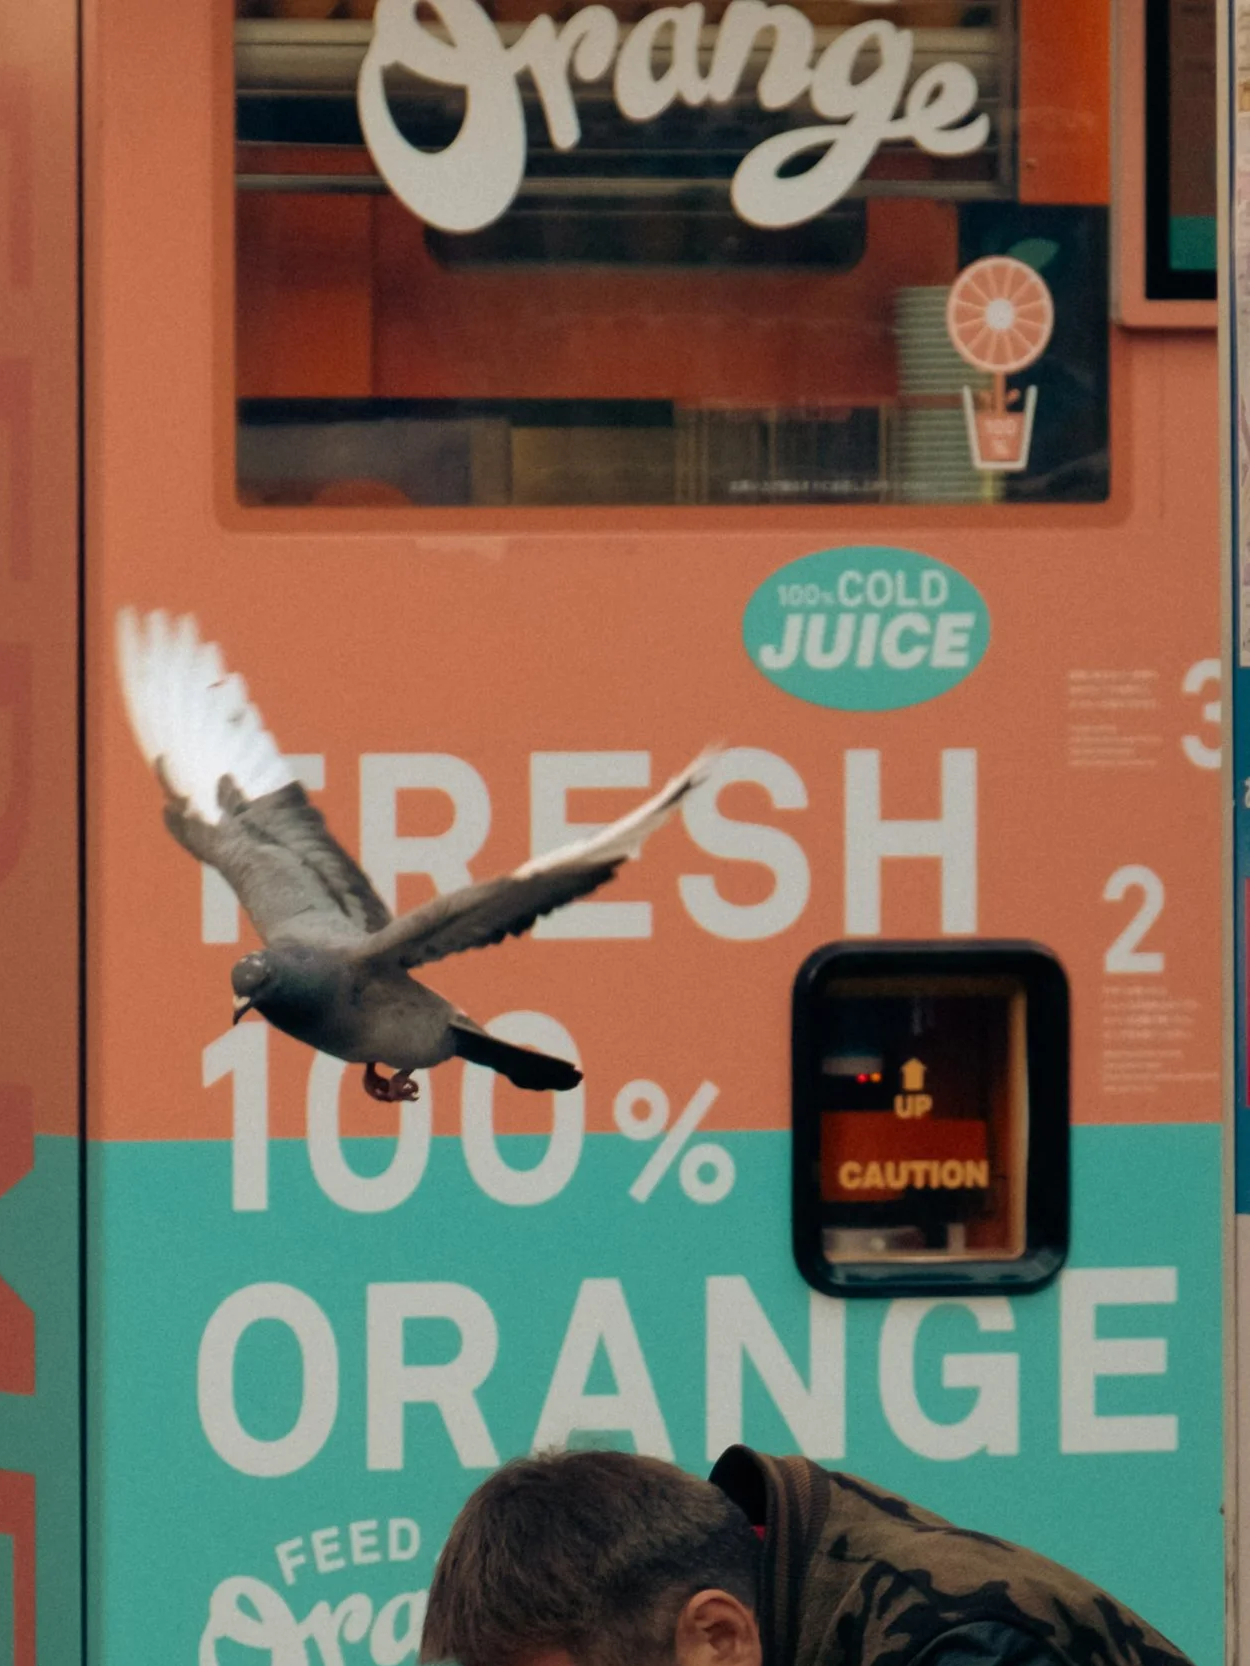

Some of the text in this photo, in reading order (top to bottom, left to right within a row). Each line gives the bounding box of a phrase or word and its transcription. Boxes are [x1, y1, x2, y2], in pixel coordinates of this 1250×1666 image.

[357, 0, 990, 233] Orange
[838, 568, 949, 608] COLD
[758, 611, 976, 670] JUICE
[1103, 863, 1165, 974] 2
[202, 1010, 736, 1214] 100%
[893, 1093, 933, 1120] UP
[838, 1160, 990, 1191] CAUTION
[196, 1266, 1178, 1479] ORANGE
[274, 1517, 421, 1586] FEED
